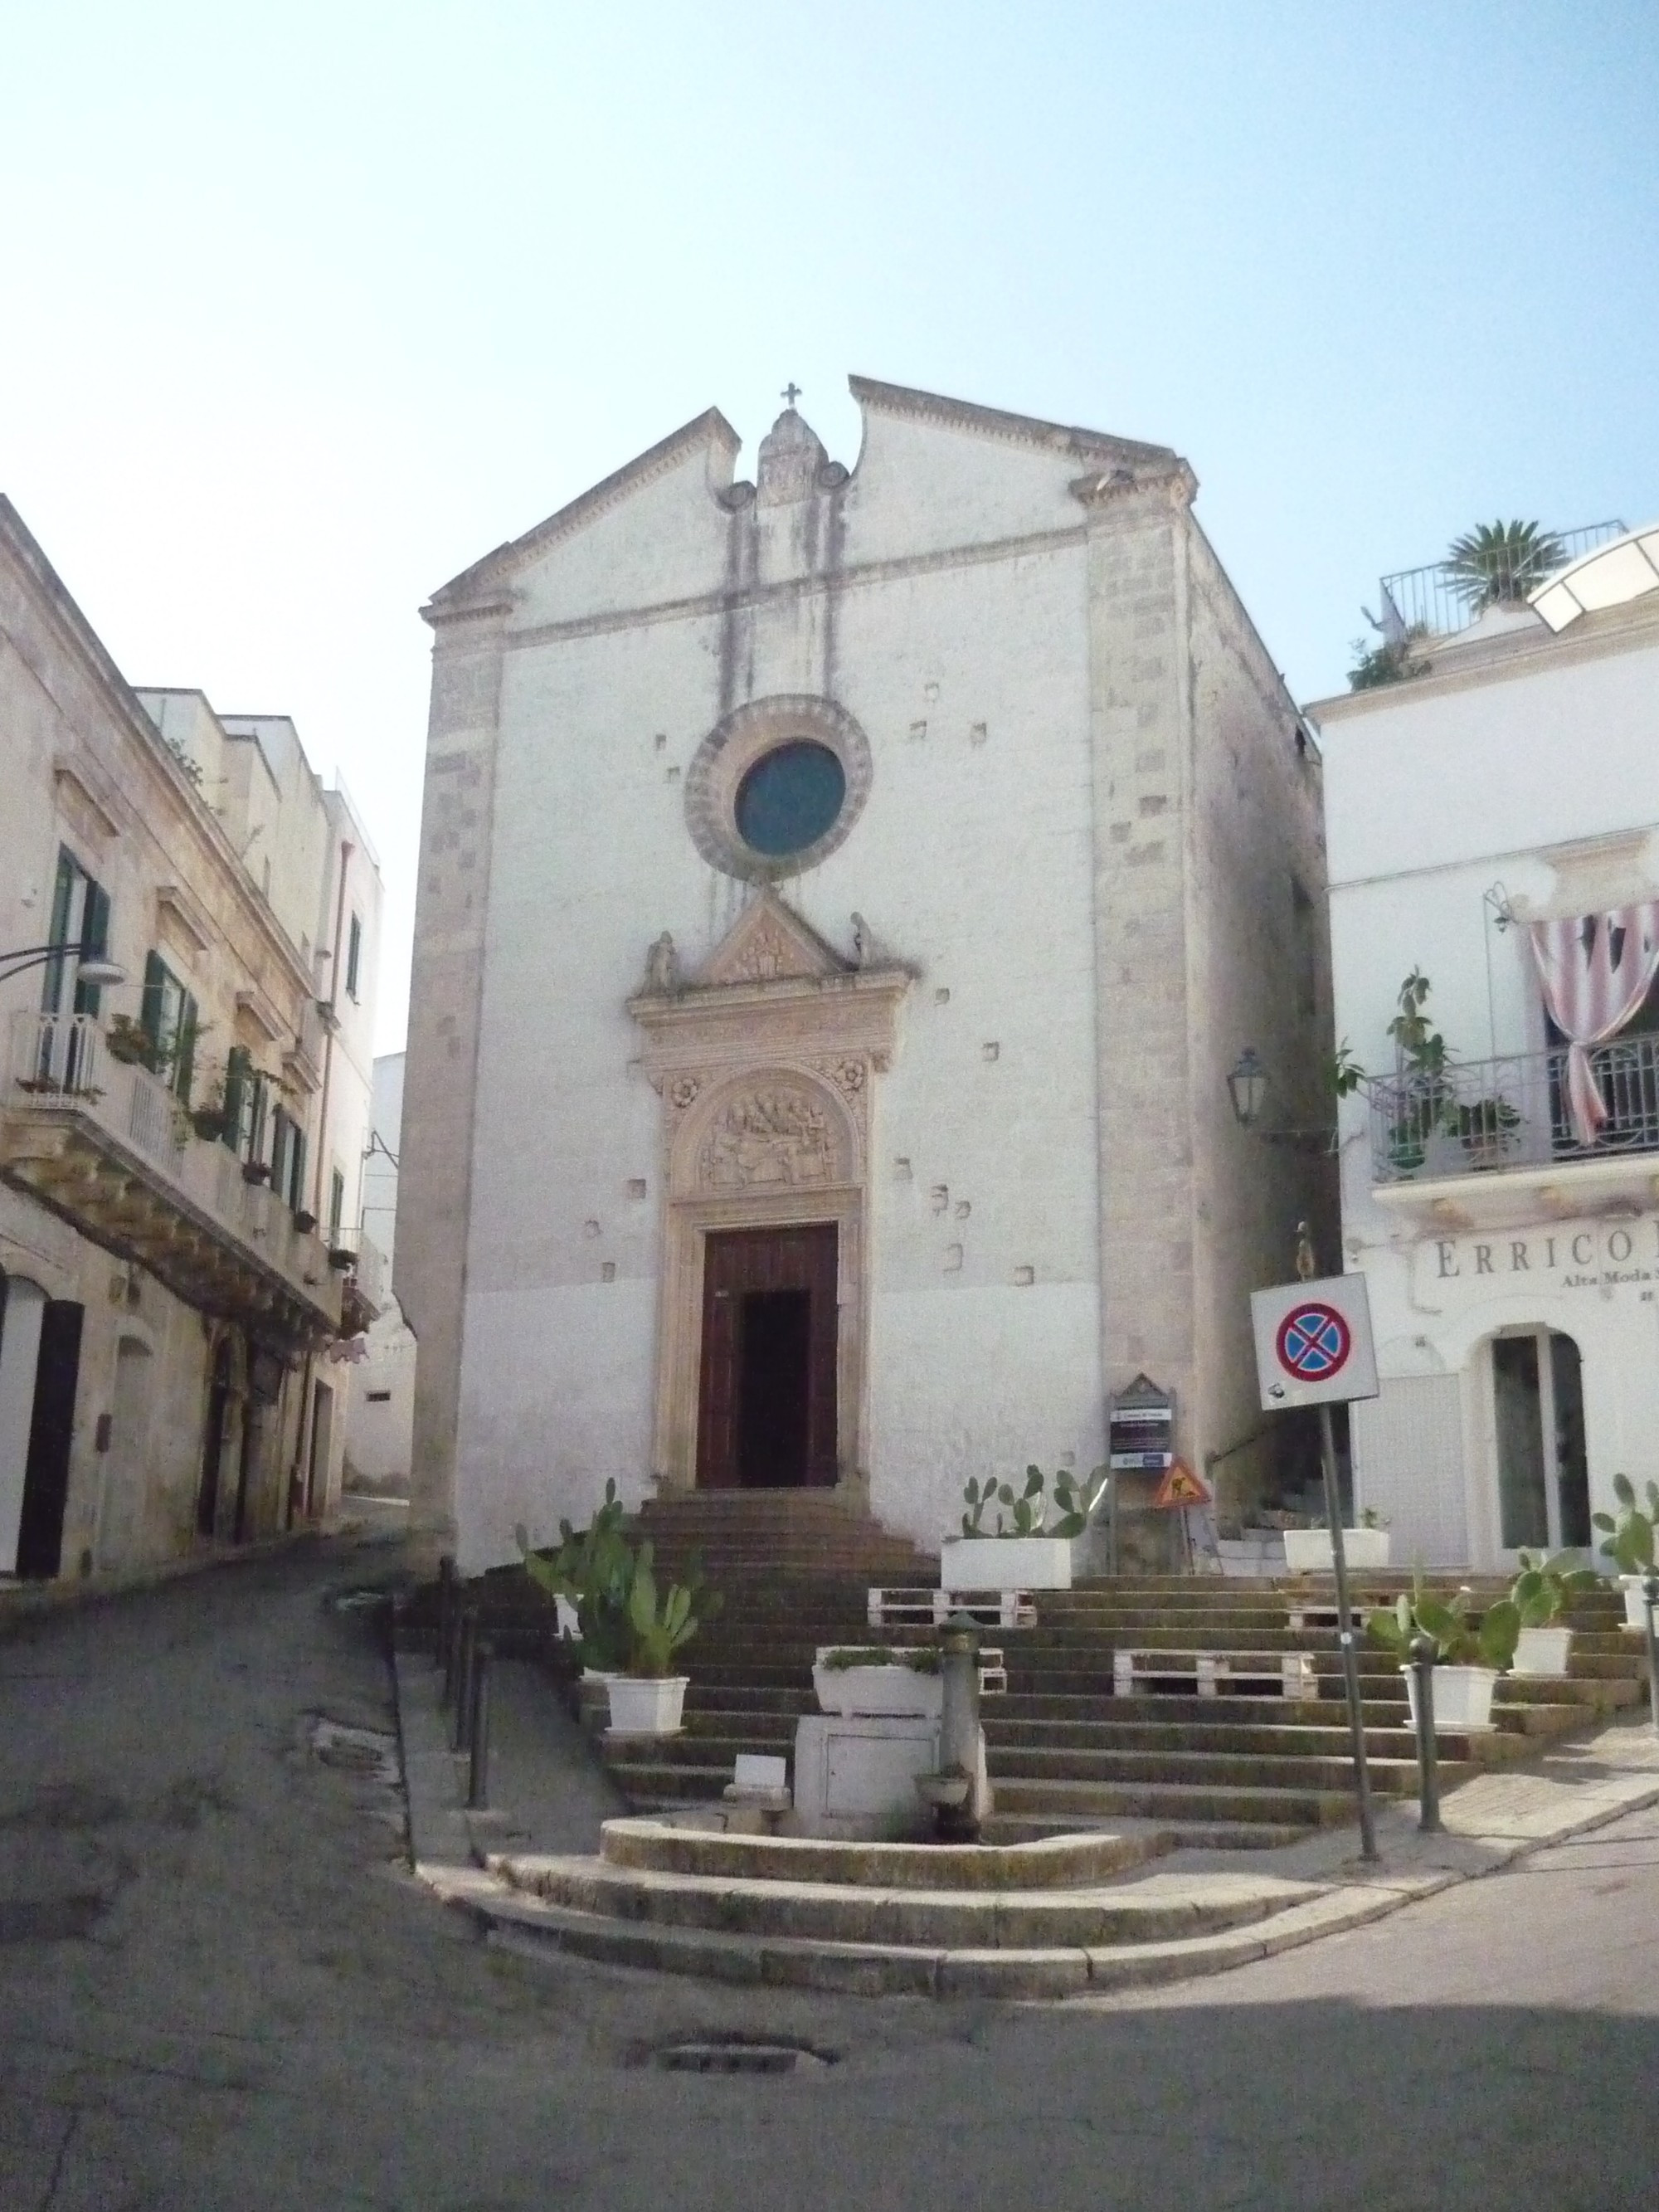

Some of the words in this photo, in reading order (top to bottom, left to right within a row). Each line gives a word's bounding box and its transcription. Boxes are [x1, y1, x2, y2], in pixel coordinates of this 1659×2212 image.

[1435, 1230, 1632, 1278] ERRICO
[1563, 1275, 1597, 1288] Alta
[1601, 1269, 1652, 1285] Moda
